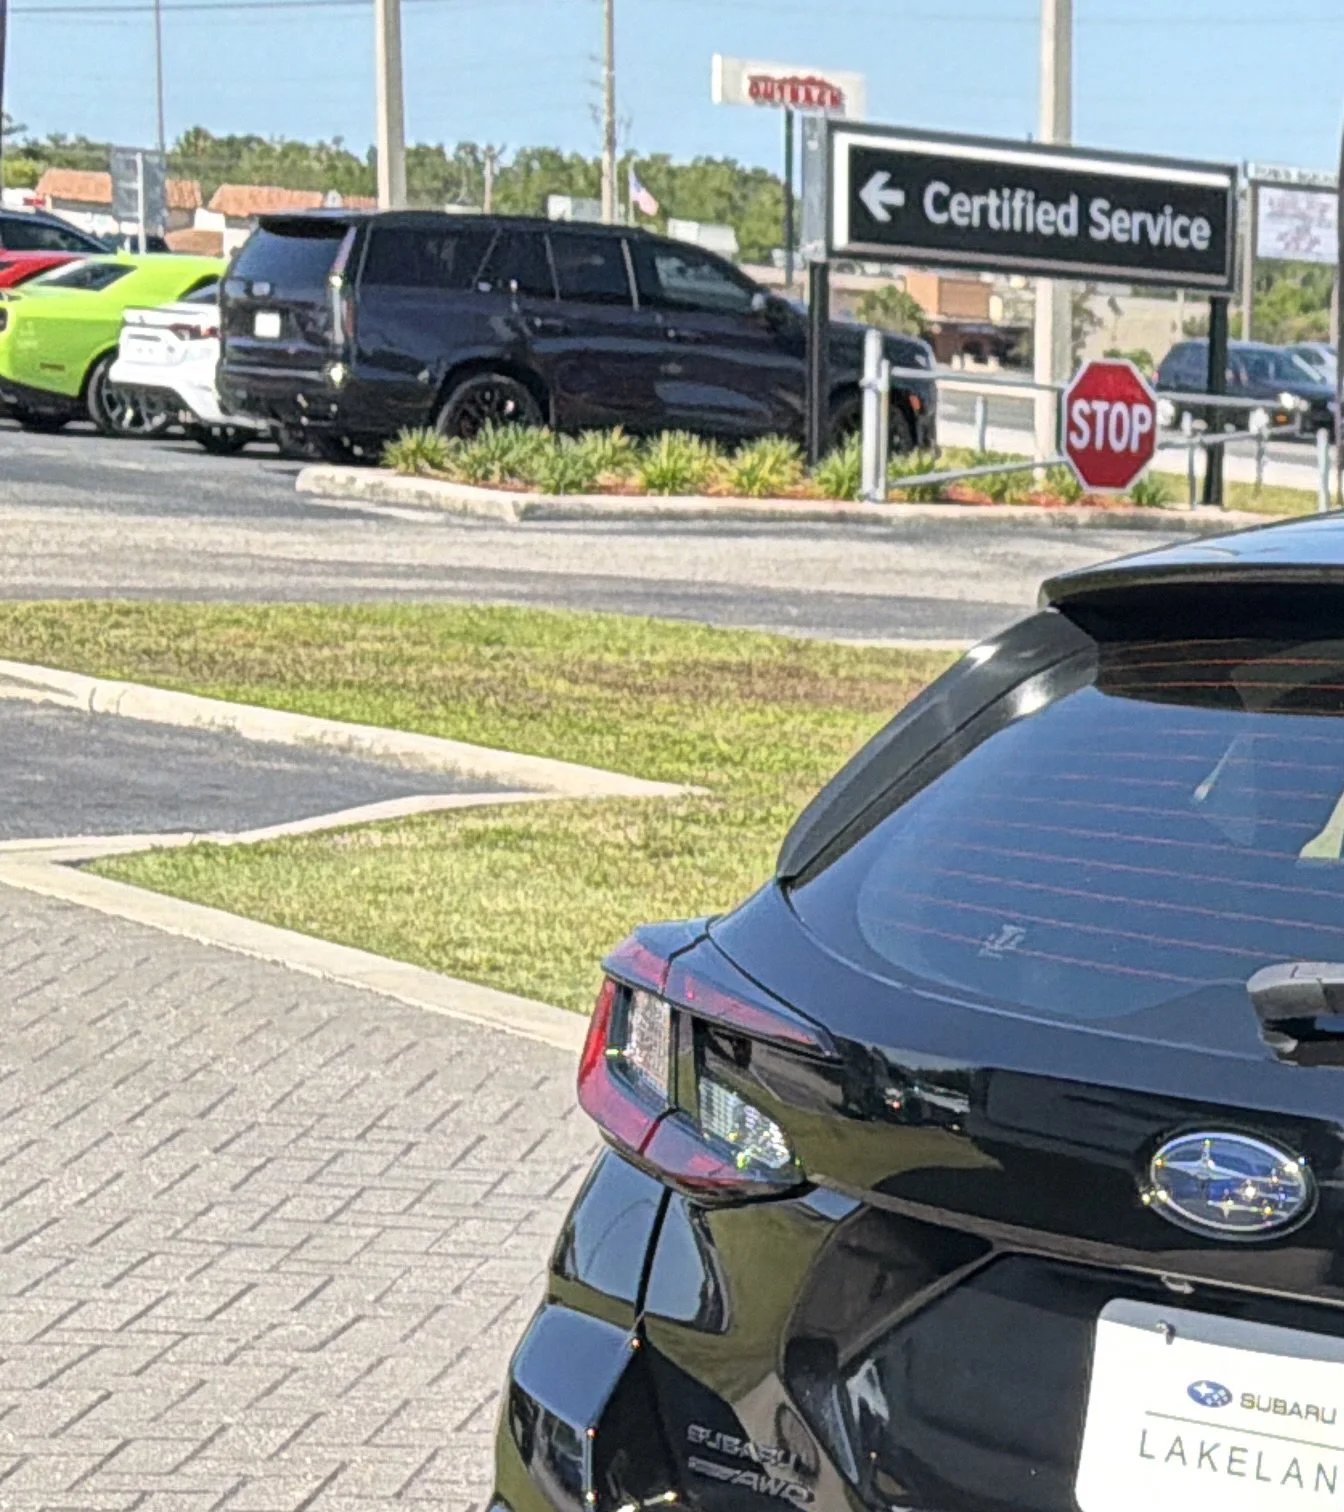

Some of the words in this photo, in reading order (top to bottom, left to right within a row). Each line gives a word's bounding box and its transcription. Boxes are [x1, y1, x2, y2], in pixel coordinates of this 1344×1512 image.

[922, 180, 1079, 238] Certified
[1088, 198, 1212, 251] Service
[1069, 398, 1153, 453] STOP
[1239, 1392, 1338, 1426] SUBARU
